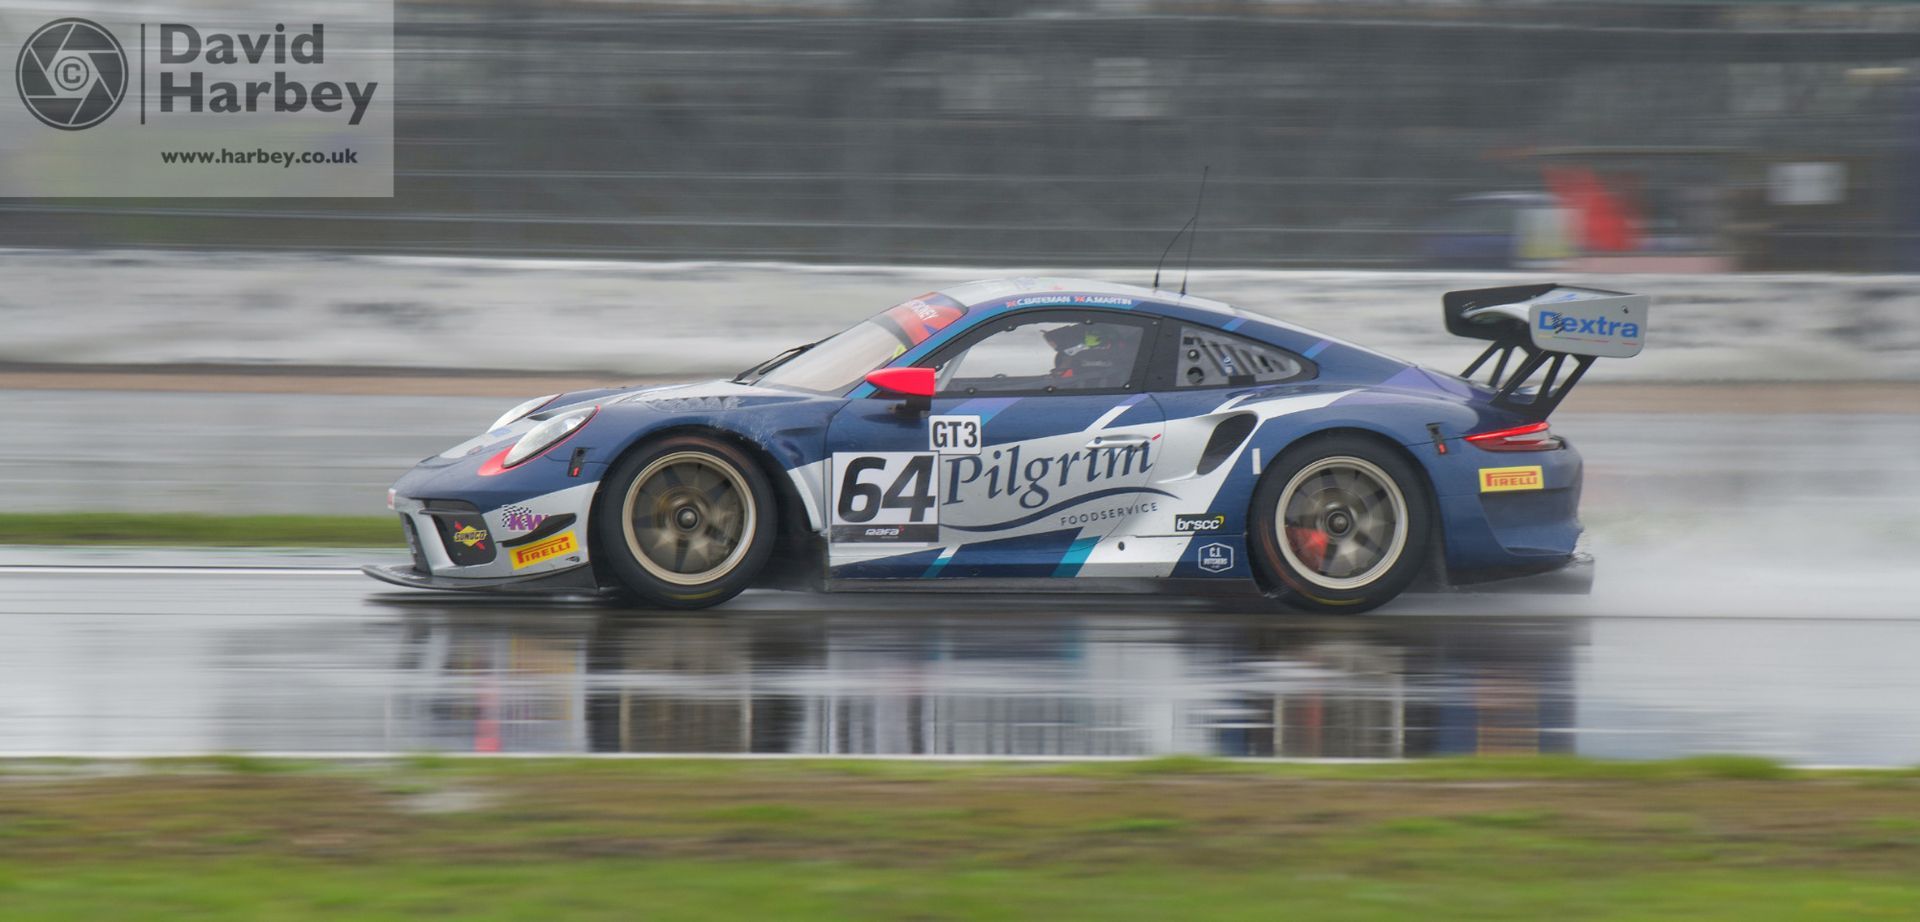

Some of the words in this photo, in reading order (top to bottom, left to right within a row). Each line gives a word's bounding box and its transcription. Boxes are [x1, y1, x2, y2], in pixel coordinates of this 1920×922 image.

[1538, 311, 1639, 338] Dextra
[932, 420, 977, 448] GT3
[838, 455, 936, 523] 64
[942, 443, 1153, 509] Pilgrim
[1485, 470, 1537, 487] PIRELLI
[1061, 502, 1158, 526] FOODSERVICE
[1176, 517, 1220, 530] brscc
[455, 530, 487, 542] SUNOCO
[516, 536, 571, 564] PIRELLI
